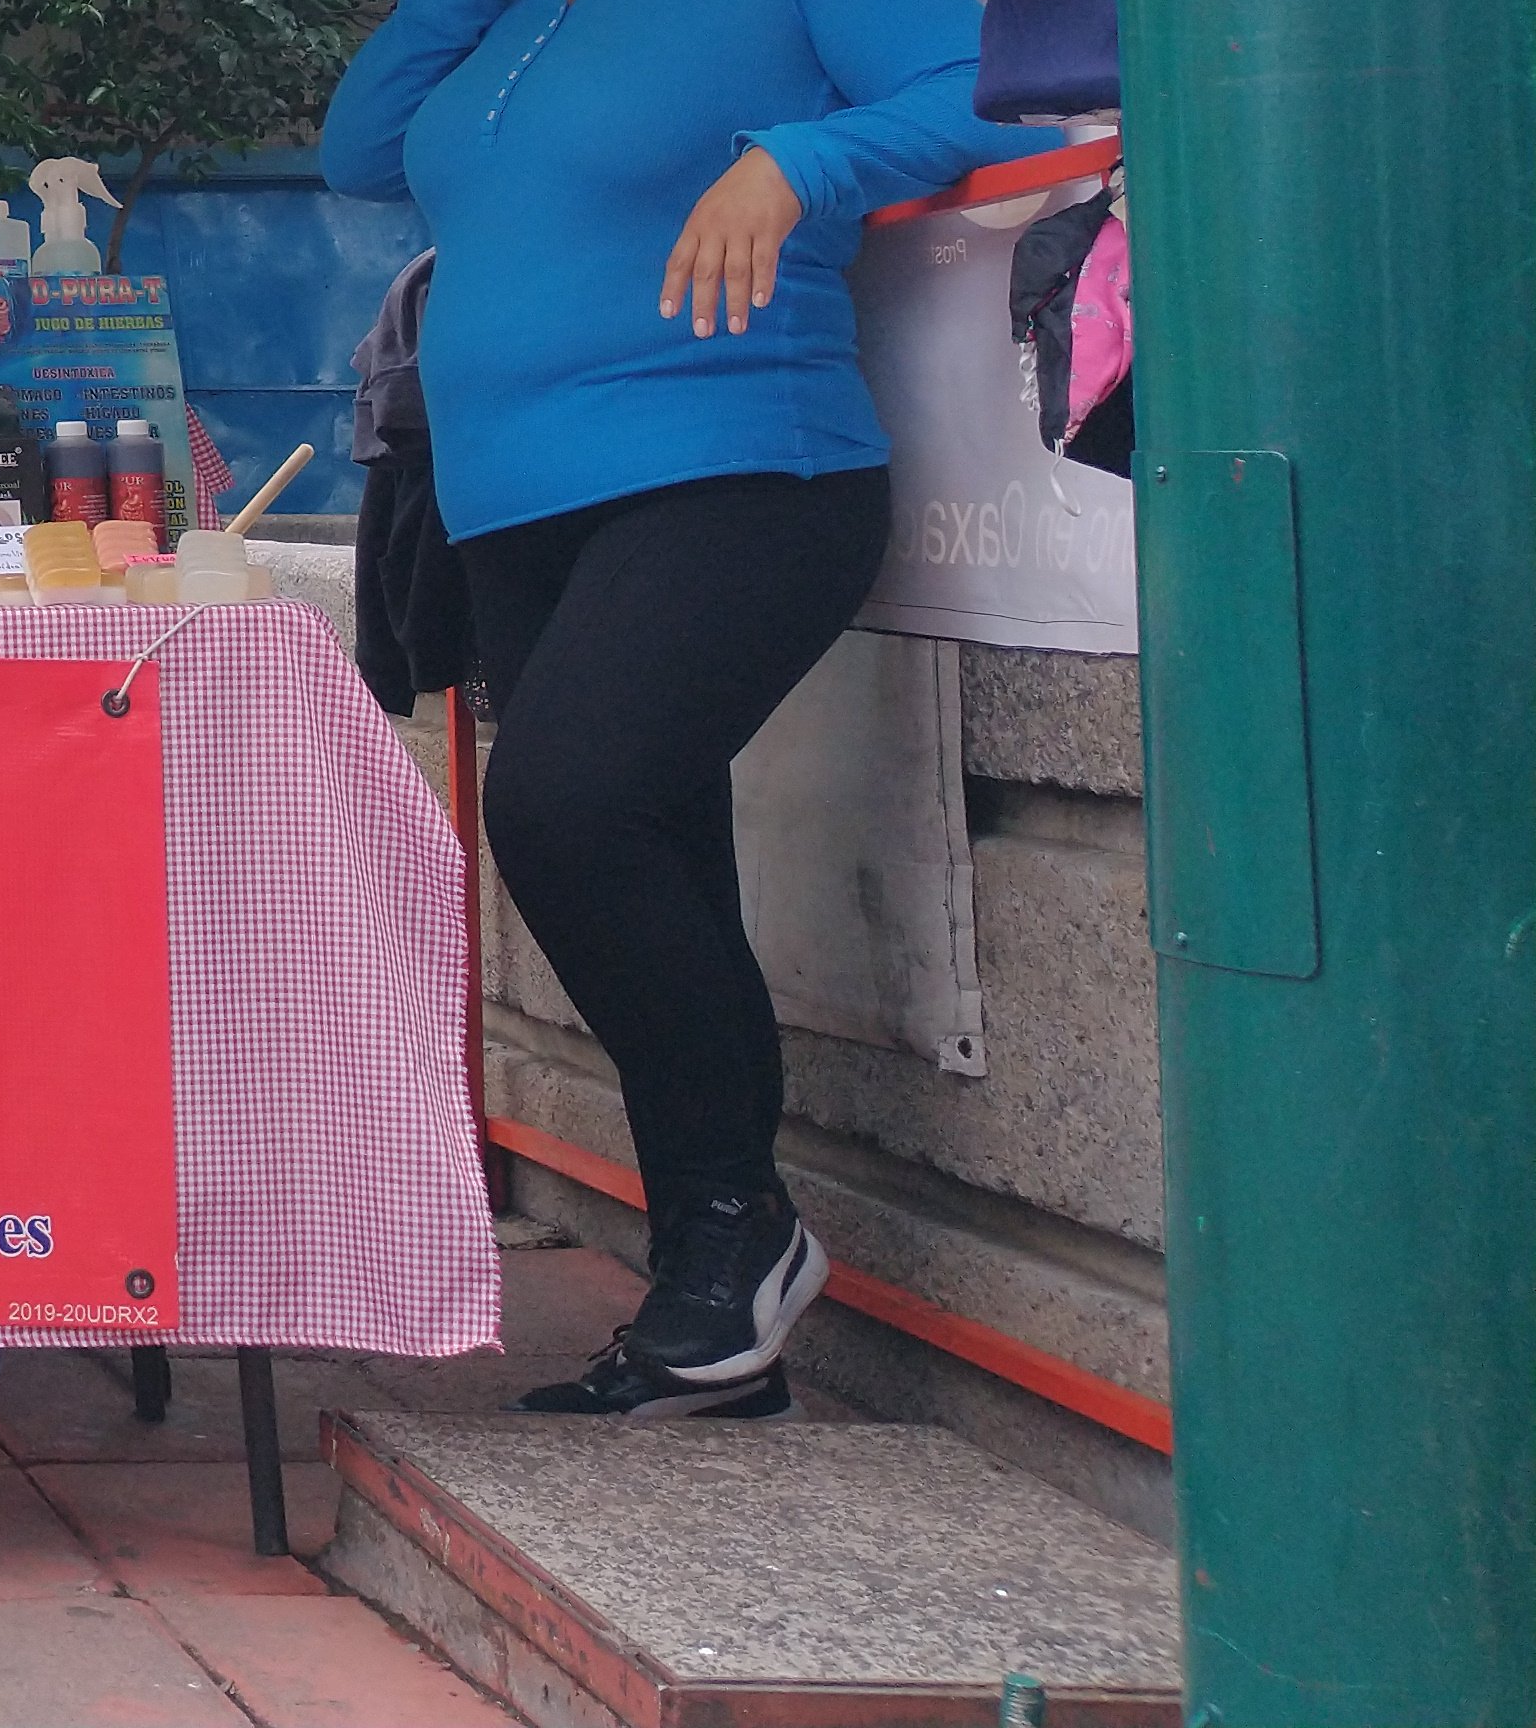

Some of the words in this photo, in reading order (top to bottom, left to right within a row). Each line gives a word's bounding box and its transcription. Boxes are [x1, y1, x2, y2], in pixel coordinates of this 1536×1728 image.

[30, 277, 161, 305] D-PURA-T
[75, 317, 93, 330] DE
[8, 1301, 160, 1326] 2019-20UDRX2
